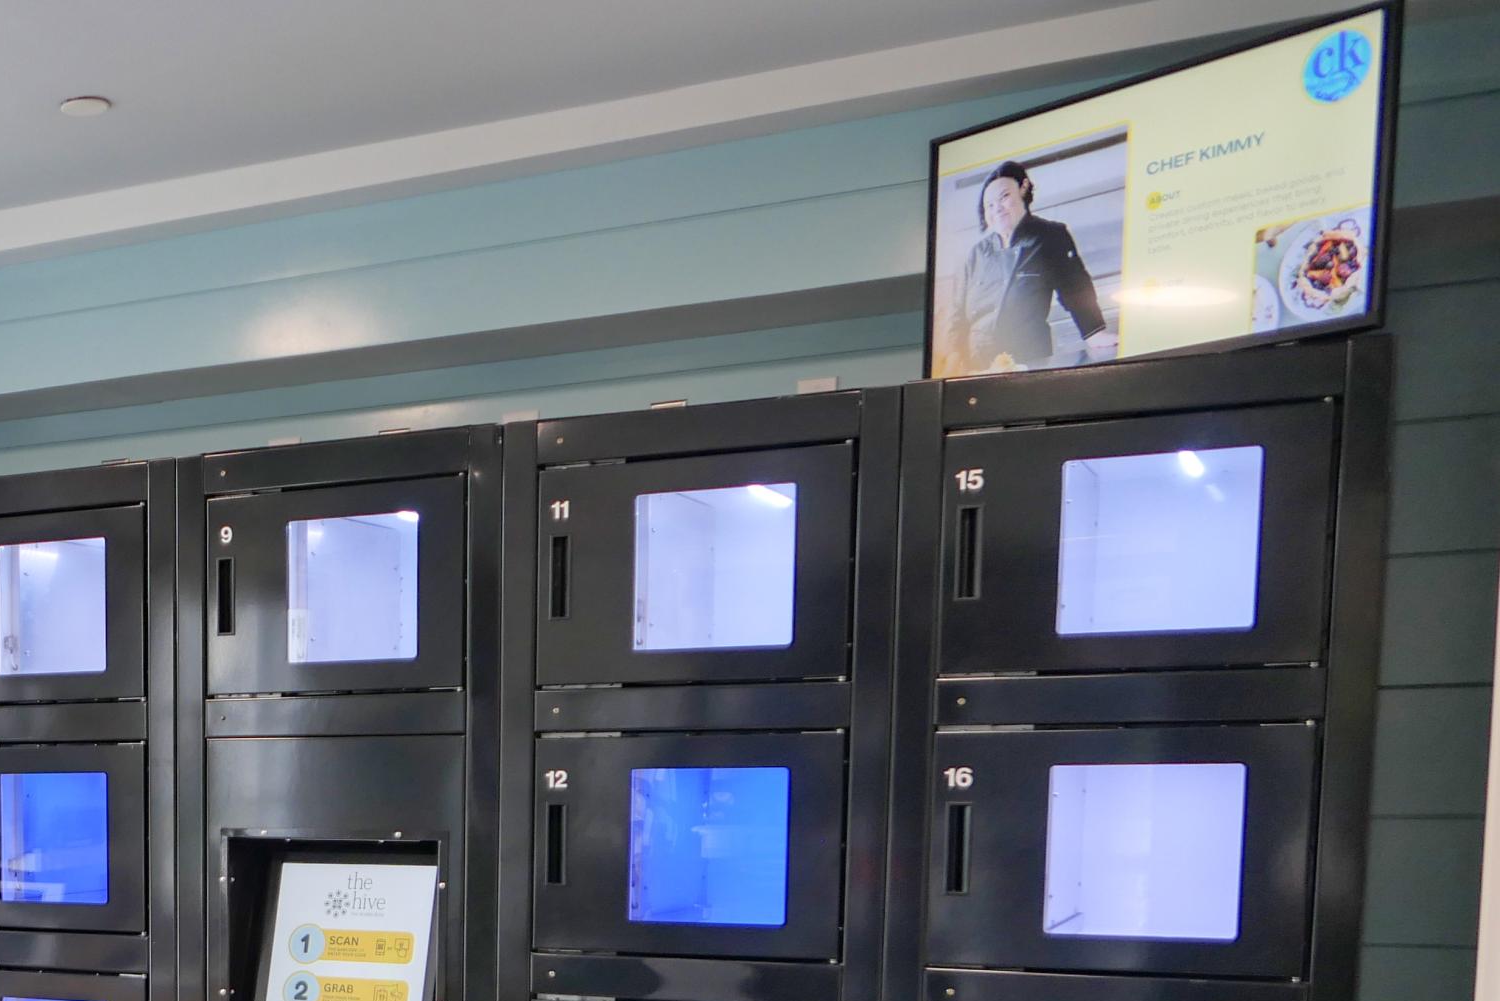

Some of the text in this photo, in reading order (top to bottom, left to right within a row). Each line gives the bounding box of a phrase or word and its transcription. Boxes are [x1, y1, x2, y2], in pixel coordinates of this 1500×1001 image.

[1146, 131, 1266, 176] CHEF KIMMY
[1150, 190, 1181, 206] ABOUT
[955, 468, 985, 491] 15
[551, 500, 570, 520] 11
[220, 526, 233, 544] 9
[545, 769, 569, 789] 12
[943, 766, 974, 788] 16
[347, 871, 373, 890] the
[351, 891, 386, 911] hive
[300, 933, 311, 954] 1
[329, 935, 359, 946] SCAN
[293, 980, 308, 1001] 2
[323, 983, 354, 994] GRAB
